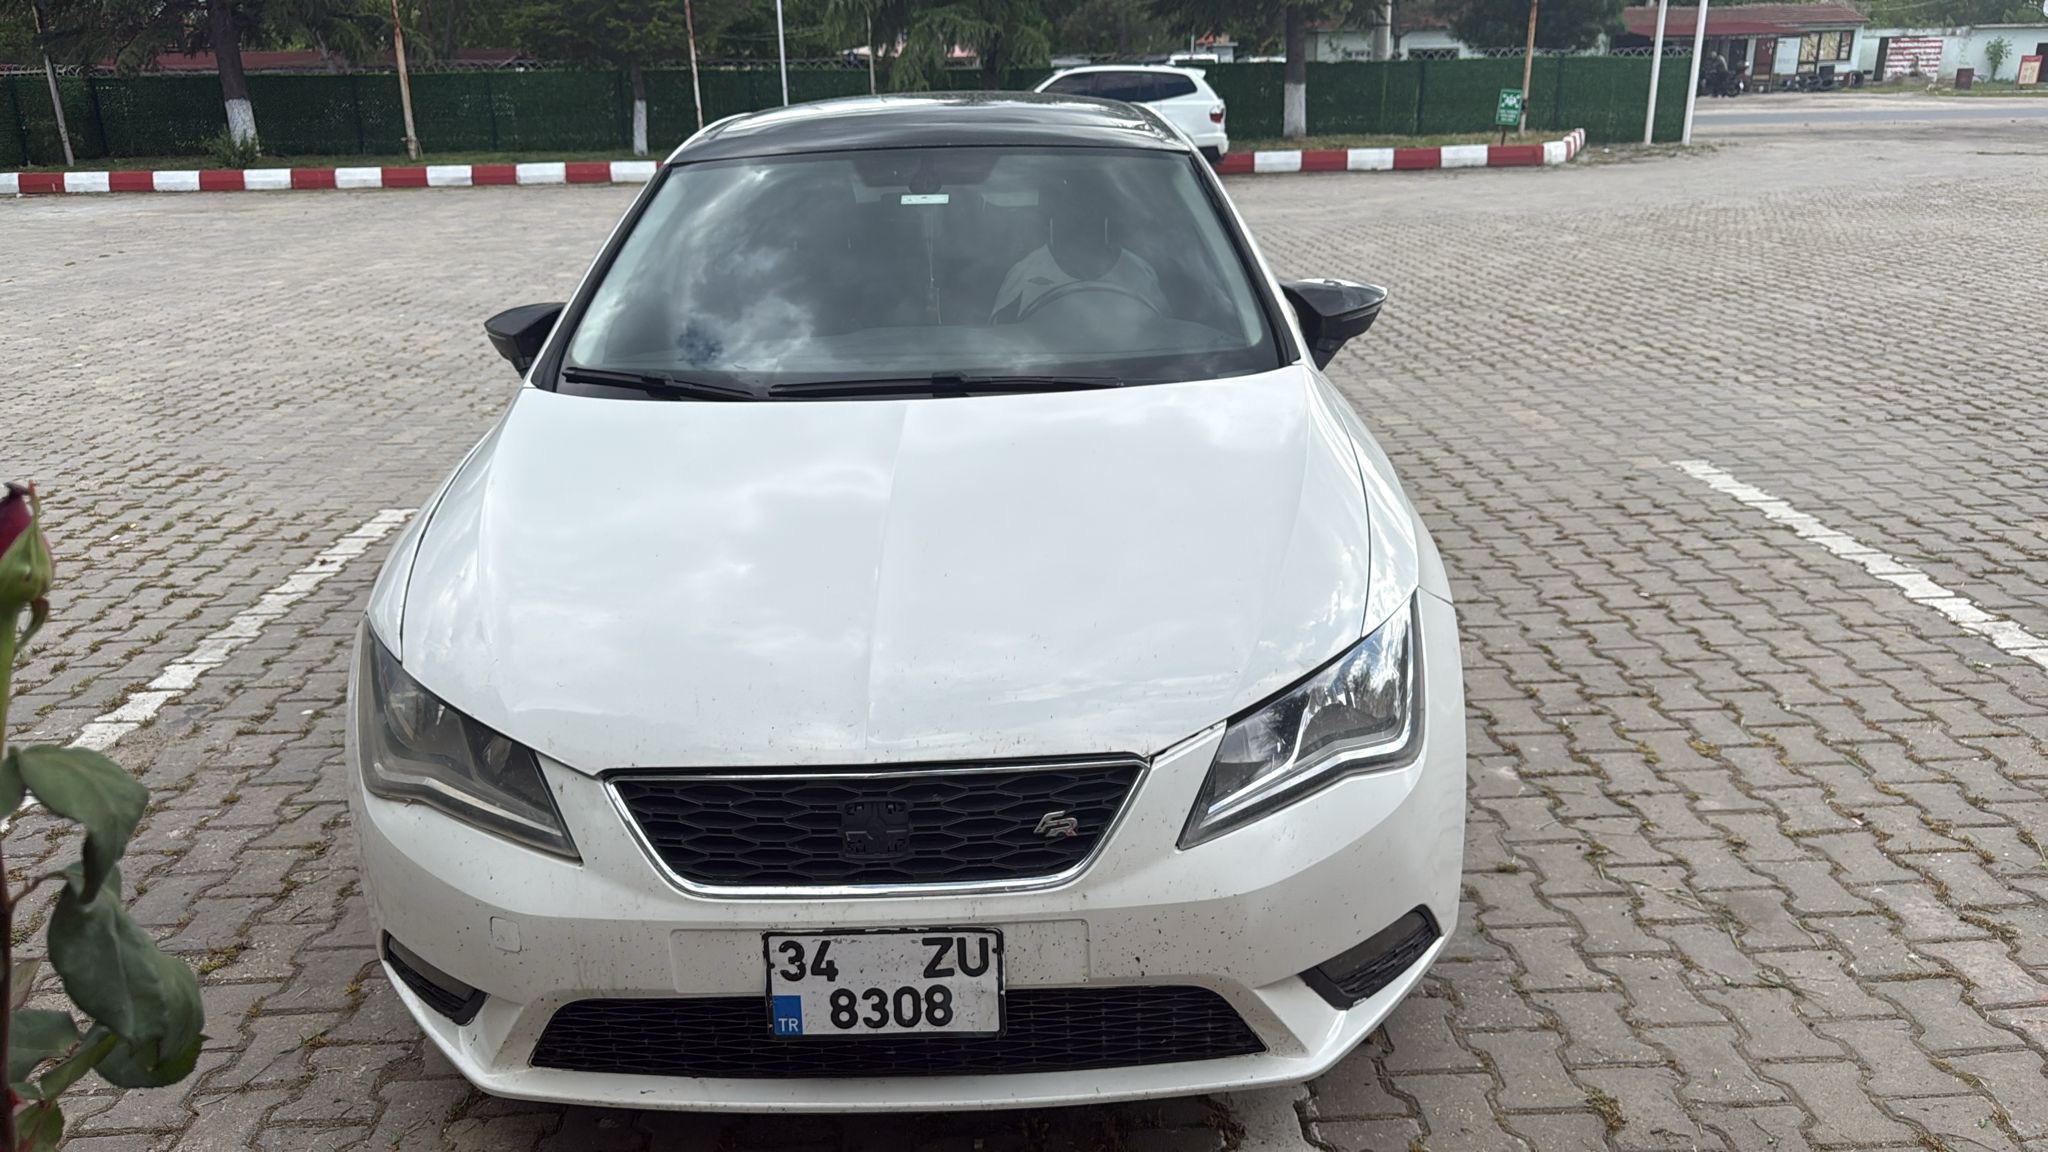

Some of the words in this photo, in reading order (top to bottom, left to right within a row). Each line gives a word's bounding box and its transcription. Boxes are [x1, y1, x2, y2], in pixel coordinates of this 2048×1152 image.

[1033, 810, 1078, 837] FR
[778, 940, 839, 982] 34
[922, 937, 989, 978] ZU
[829, 984, 954, 1029] 8308
[778, 1018, 799, 1032] TR
